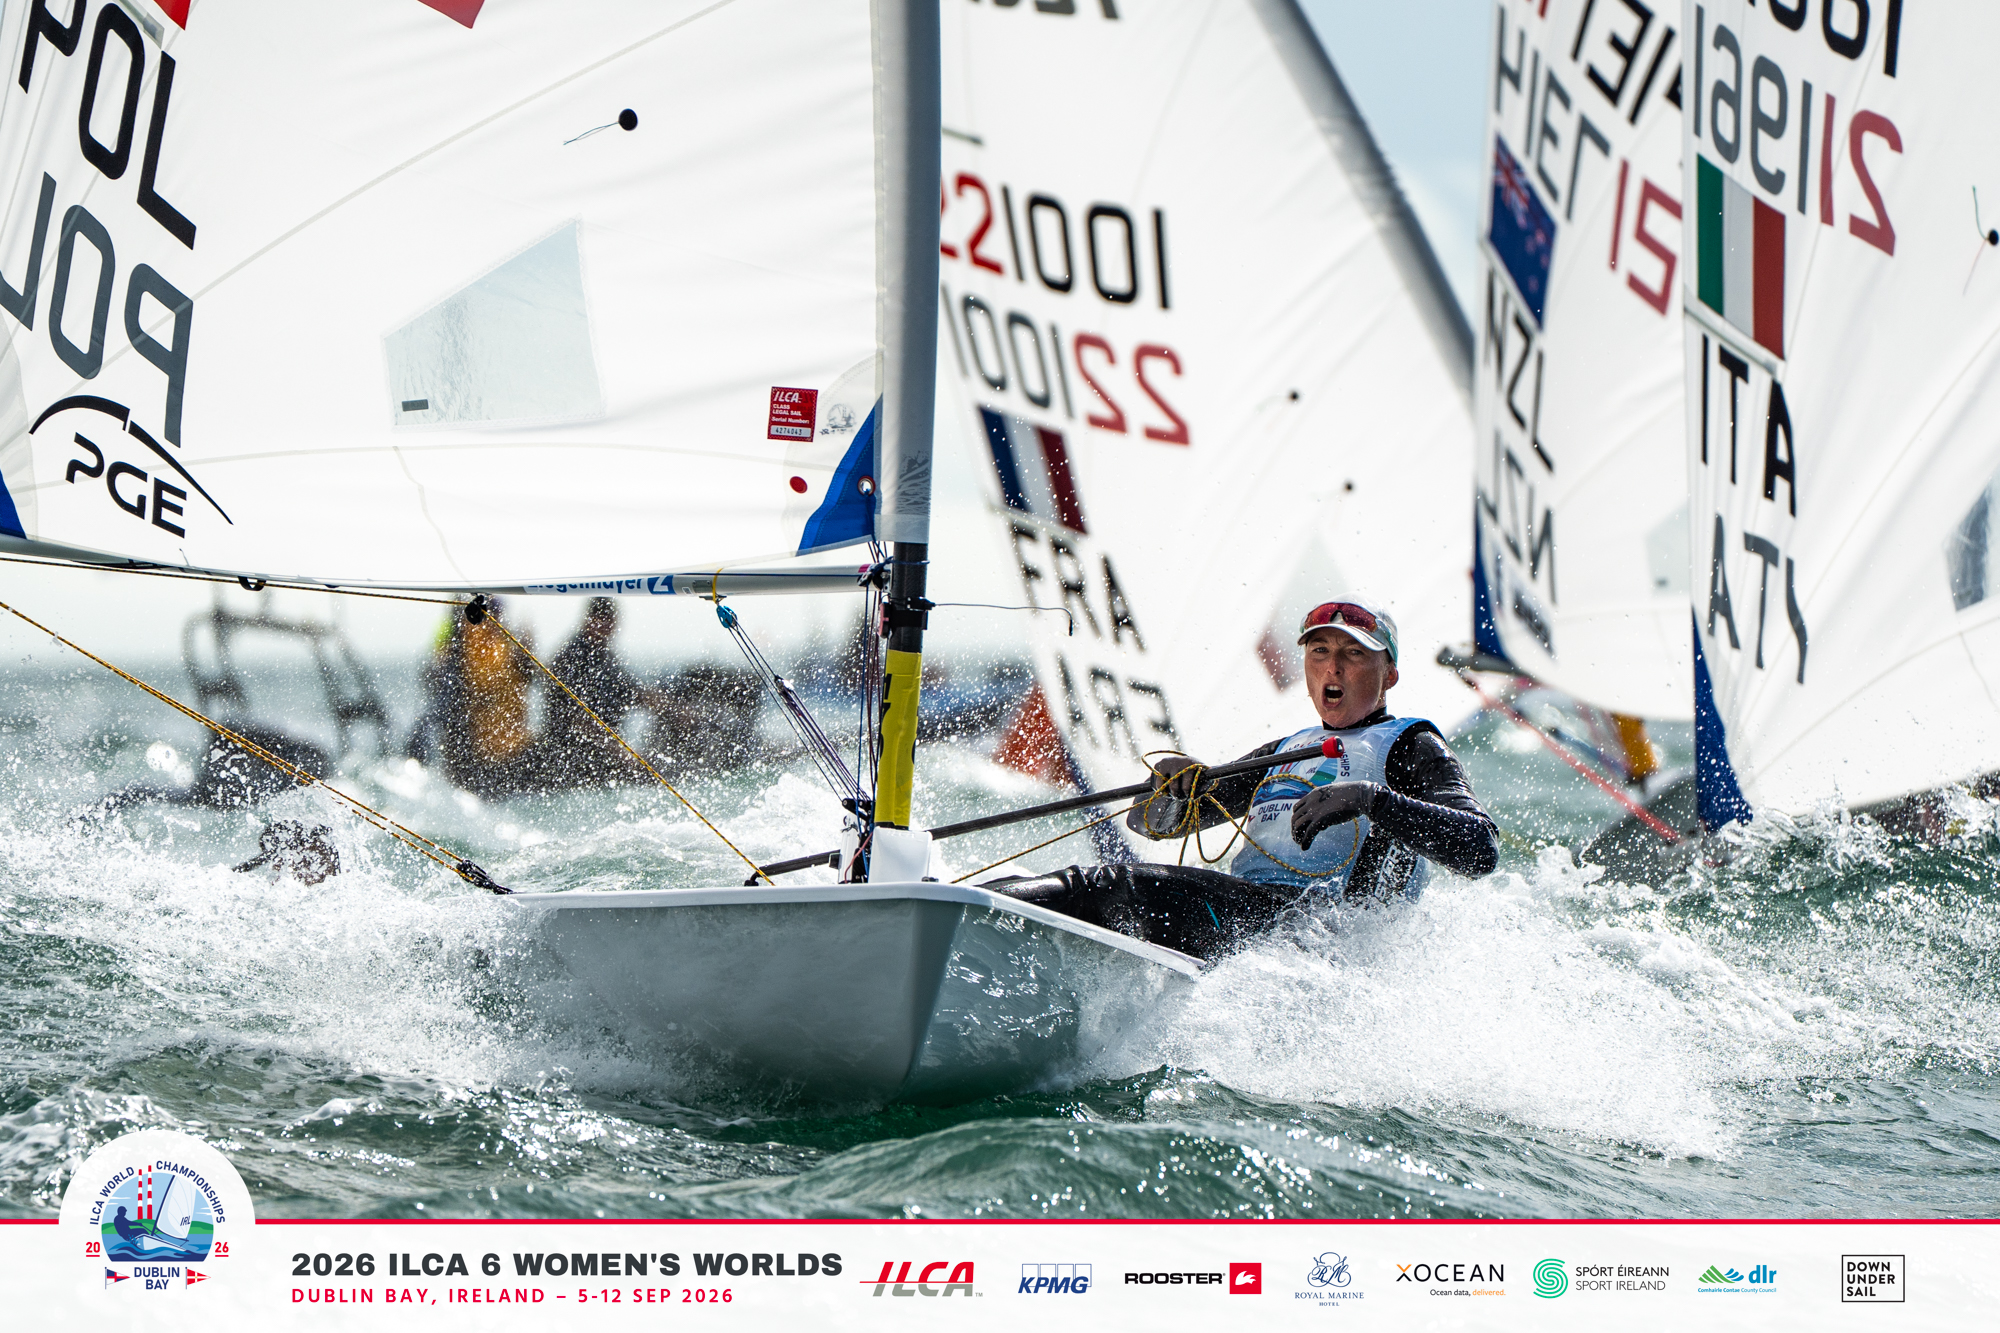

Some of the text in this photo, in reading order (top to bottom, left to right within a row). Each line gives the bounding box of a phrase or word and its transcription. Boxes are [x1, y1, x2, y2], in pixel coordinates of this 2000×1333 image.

[1702, 333, 1796, 518] ITA
[65, 431, 188, 538] PGE
[1008, 522, 1147, 654] FRA
[1258, 802, 1293, 816] DUBLIN
[1260, 811, 1281, 823] BAY
